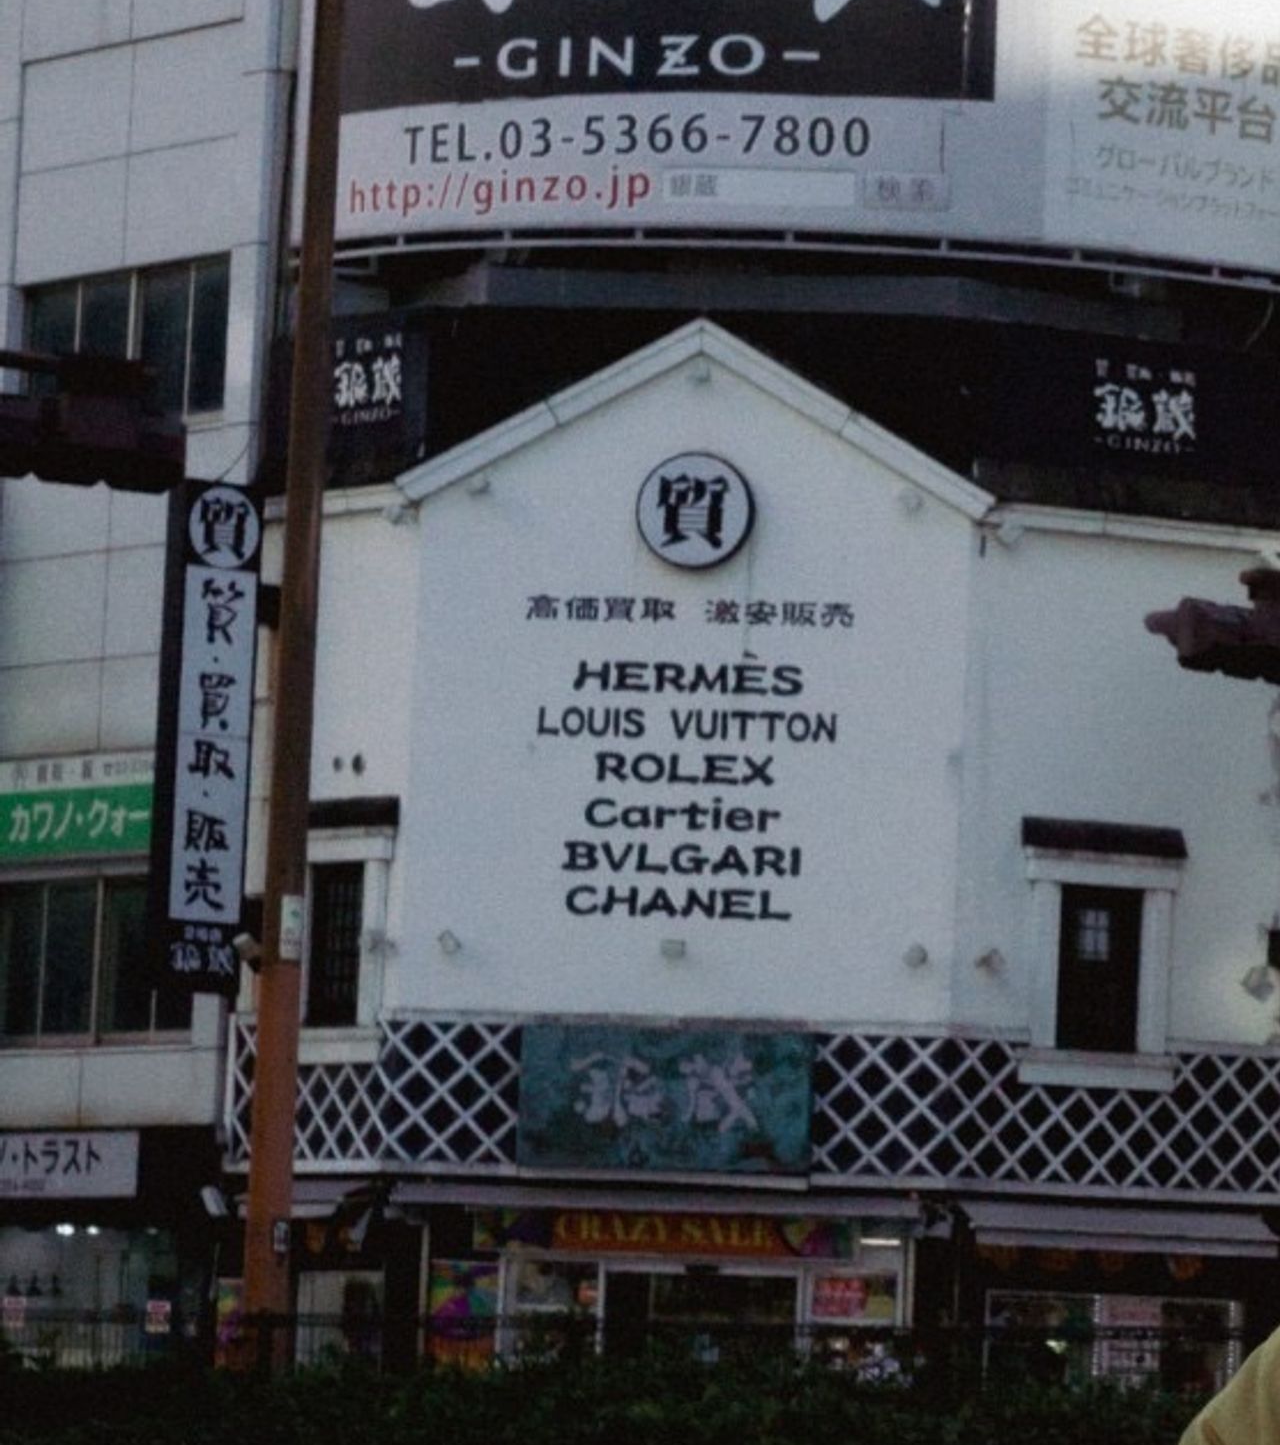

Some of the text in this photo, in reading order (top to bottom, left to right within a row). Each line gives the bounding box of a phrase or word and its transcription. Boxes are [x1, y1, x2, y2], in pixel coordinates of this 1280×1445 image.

[1096, 78, 1278, 143] 交流平台
[348, 168, 651, 217] http://ginzo.jp
[200, 495, 251, 558] 質
[656, 473, 729, 549] 質
[525, 593, 676, 624] 高価買取
[536, 706, 838, 744] LOUIS VUITTON
[594, 752, 775, 787] ROLEX
[584, 797, 781, 833] Cartier
[561, 840, 802, 877] BVLGARI
[564, 885, 793, 922] CHANEL
[554, 1213, 671, 1247] CRAZY
